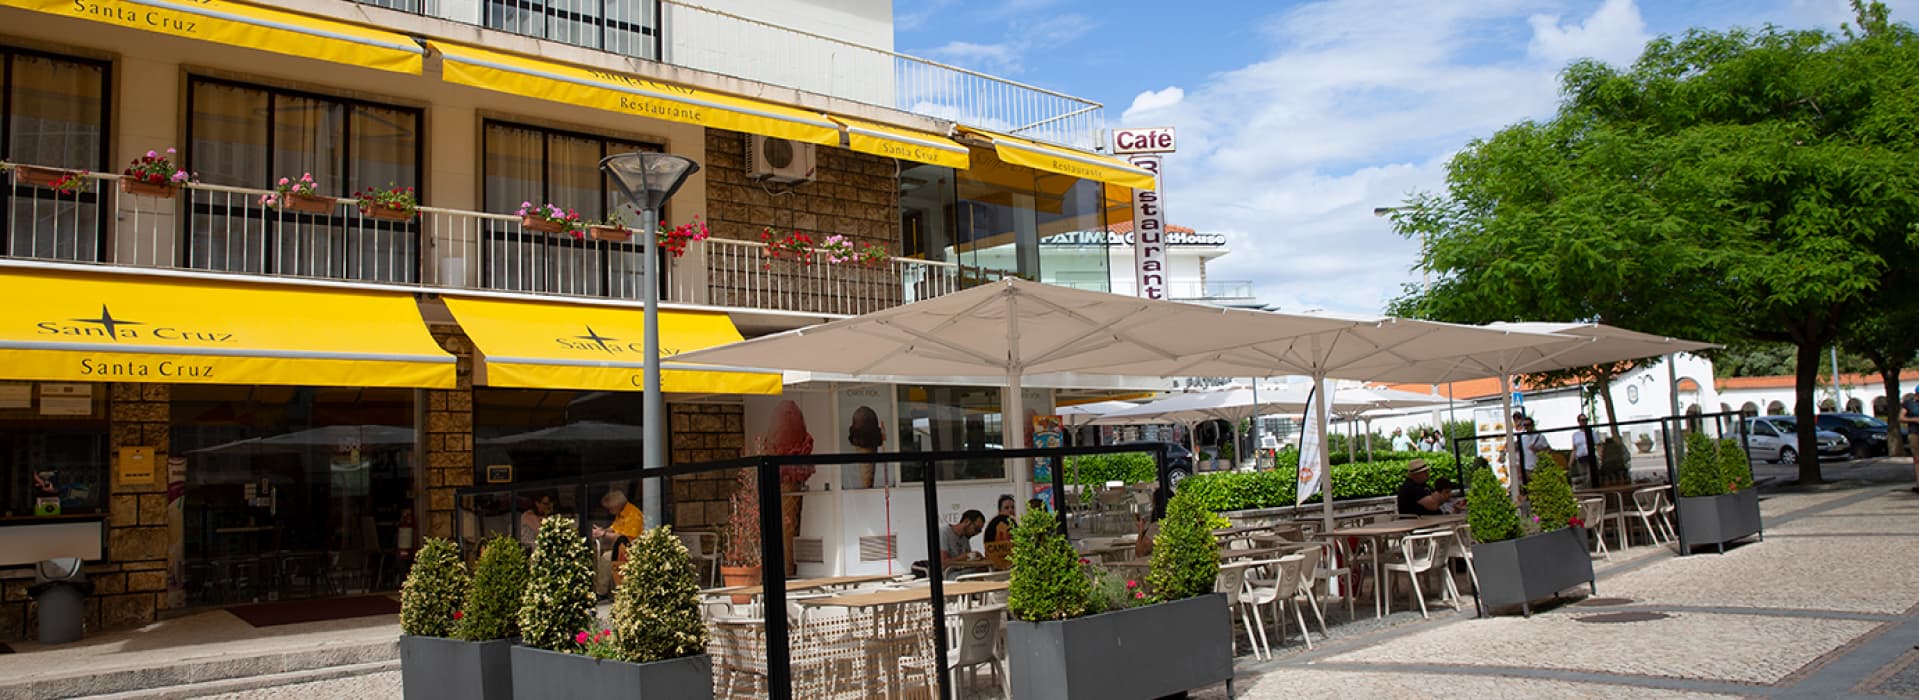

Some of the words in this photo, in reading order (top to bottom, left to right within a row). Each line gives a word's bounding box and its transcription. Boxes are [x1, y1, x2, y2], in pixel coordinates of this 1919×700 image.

[73, 0, 136, 22] Santa
[146, 11, 196, 33] Cruz
[620, 97, 702, 121] Restaurante
[1116, 129, 1172, 150] Café
[883, 143, 911, 156] Santa
[914, 148, 938, 161] Cruz
[1052, 160, 1103, 178] Restaurante
[1134, 160, 1162, 300] Rstaurant
[36, 314, 138, 341] Santa
[153, 327, 238, 342] Cruz
[556, 332, 624, 355] Santa
[81, 358, 148, 376] Santa
[159, 361, 214, 377] Cruz
